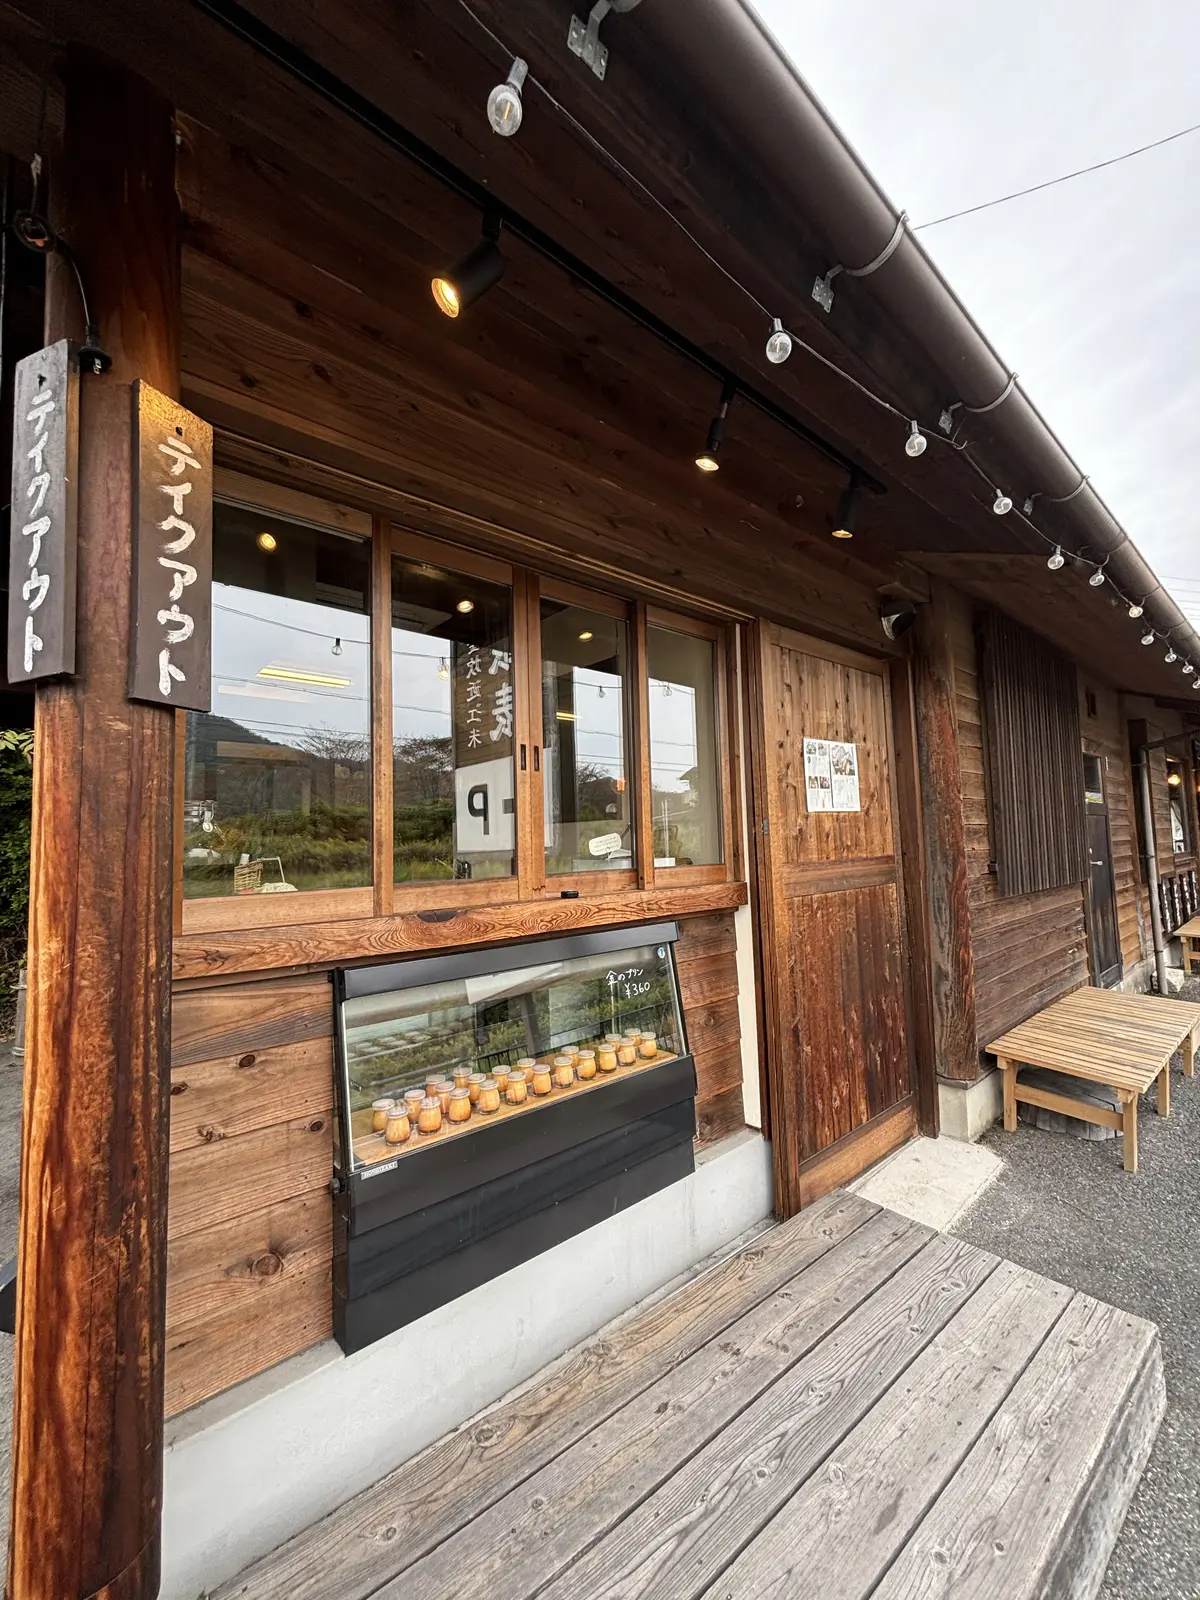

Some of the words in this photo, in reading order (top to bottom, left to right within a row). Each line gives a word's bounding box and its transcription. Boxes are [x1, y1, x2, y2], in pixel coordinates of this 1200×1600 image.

[22, 389, 56, 673] テイクアウト
[157, 435, 202, 696] テイクアウト
[605, 968, 644, 986] 金のプリン
[624, 981, 651, 999] ¥360
